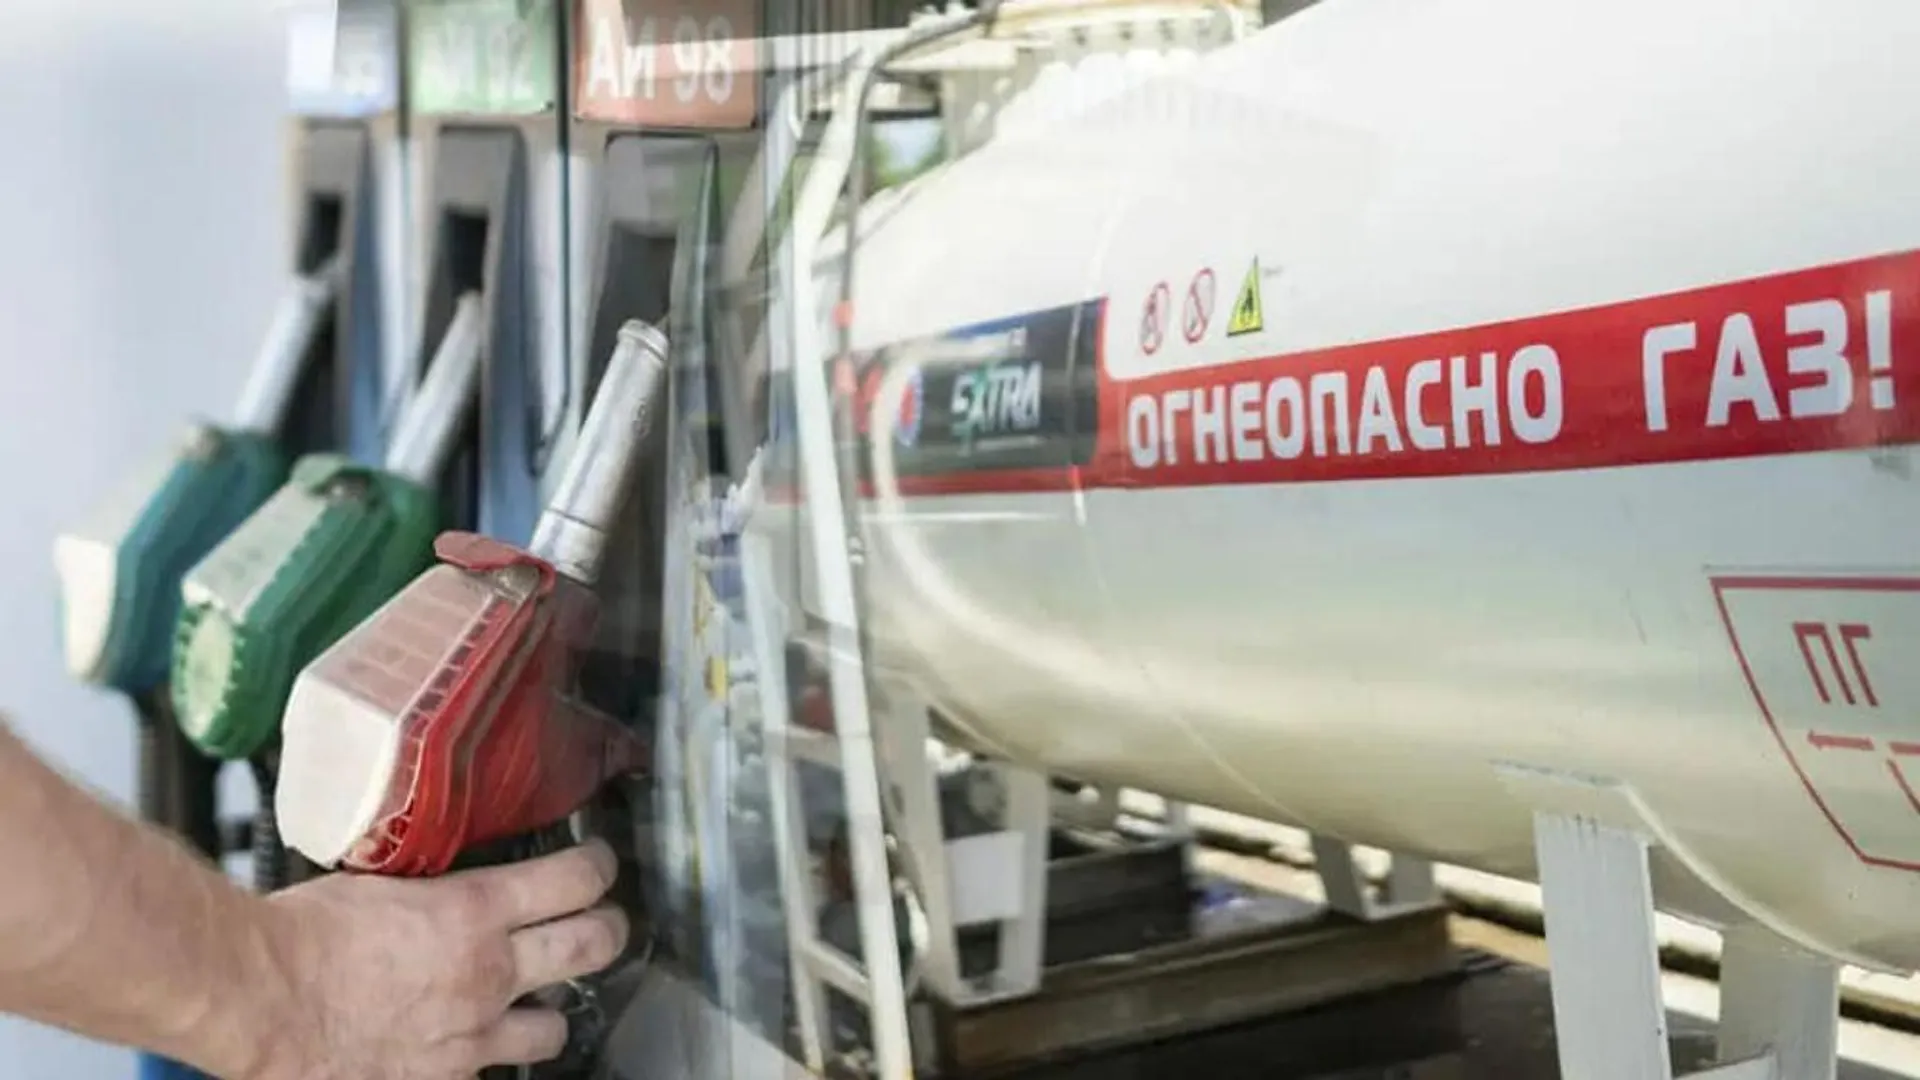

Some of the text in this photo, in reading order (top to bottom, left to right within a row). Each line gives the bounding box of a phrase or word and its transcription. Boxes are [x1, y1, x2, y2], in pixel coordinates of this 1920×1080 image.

[586, 14, 733, 104] АИ 98
[950, 361, 1043, 433] EXTRA
[1127, 290, 1896, 470] ОГНЕОПАСНО ГАЗ!
[1792, 622, 1880, 708] ПГ
